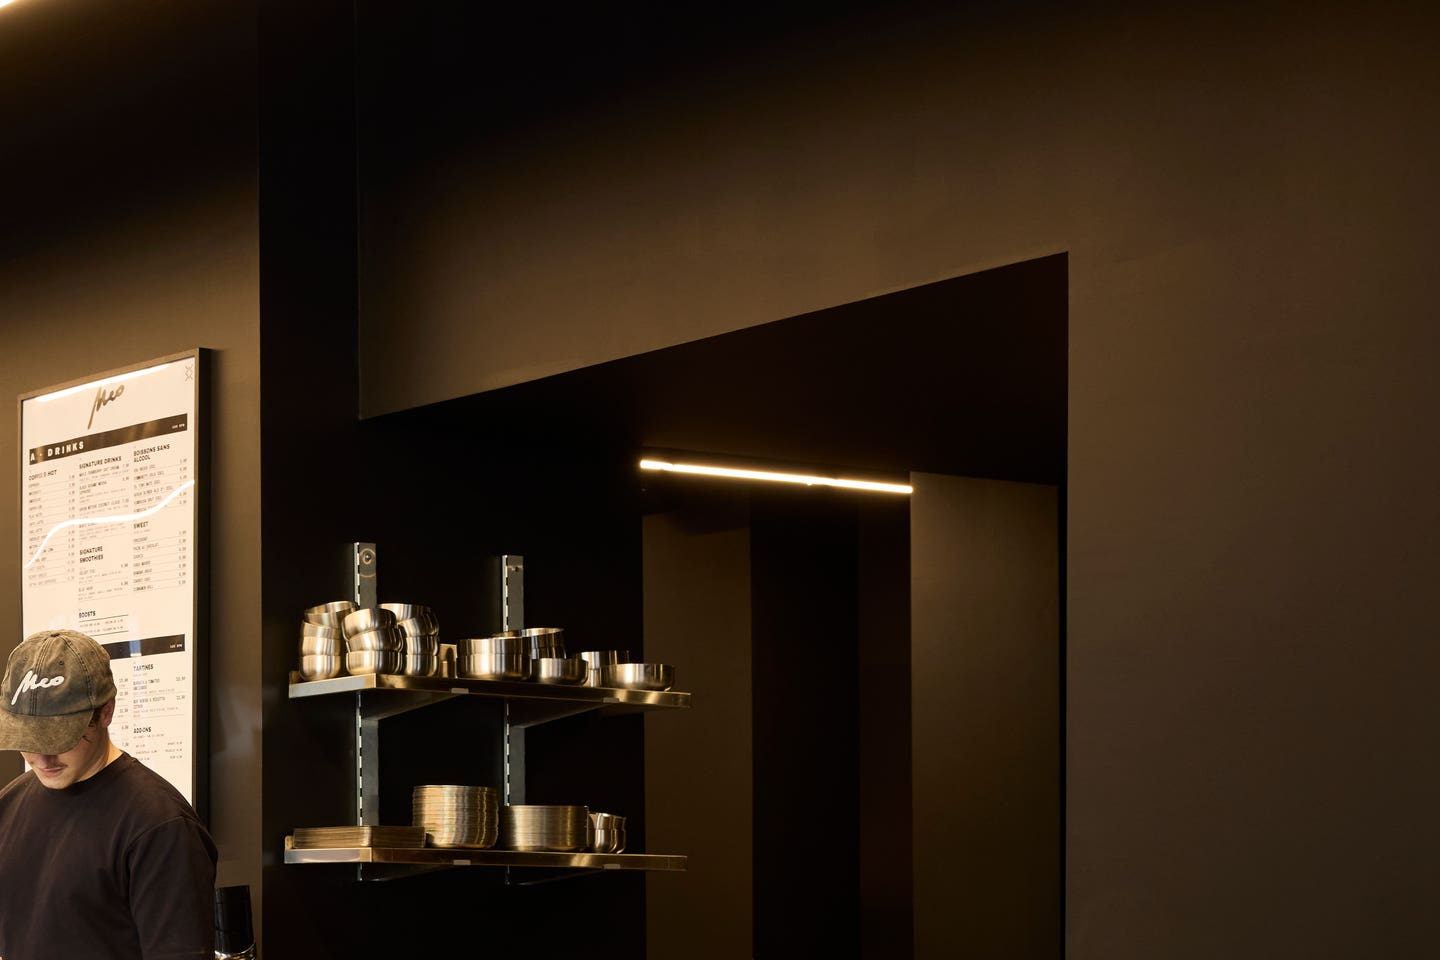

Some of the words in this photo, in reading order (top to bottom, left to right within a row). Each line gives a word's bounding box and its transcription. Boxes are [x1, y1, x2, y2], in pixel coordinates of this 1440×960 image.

[30, 451, 36, 462] A
[47, 441, 85, 457] DRINKS
[156, 443, 171, 453] SANS
[79, 459, 103, 470] SIGNATURE
[104, 455, 122, 465] DRINKS
[133, 521, 149, 529] SWEET
[79, 546, 103, 556] SIGNATURE
[79, 554, 104, 564] SMOOTHIES
[78, 610, 96, 619] BOOSTS
[133, 663, 154, 672] TARTINES
